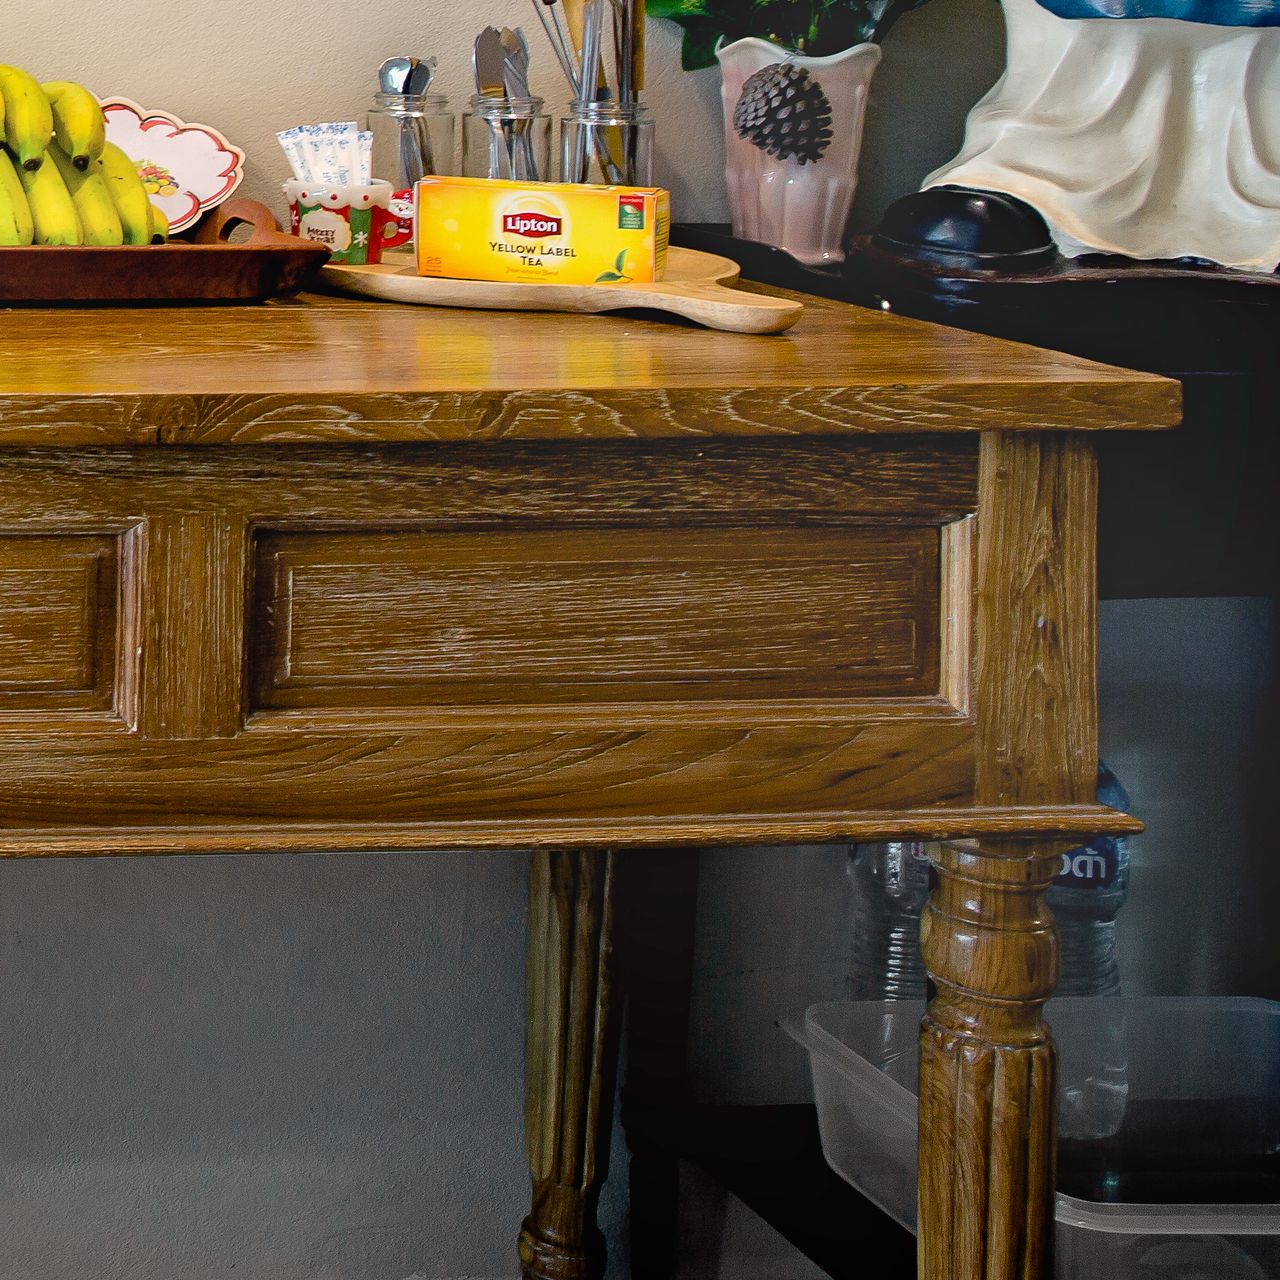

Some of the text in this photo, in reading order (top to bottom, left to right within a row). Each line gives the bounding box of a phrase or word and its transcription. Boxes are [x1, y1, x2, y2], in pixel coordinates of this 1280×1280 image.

[506, 216, 557, 233] Lipton
[489, 241, 577, 257] YELLOW LABEL
[520, 255, 544, 266] TEA
